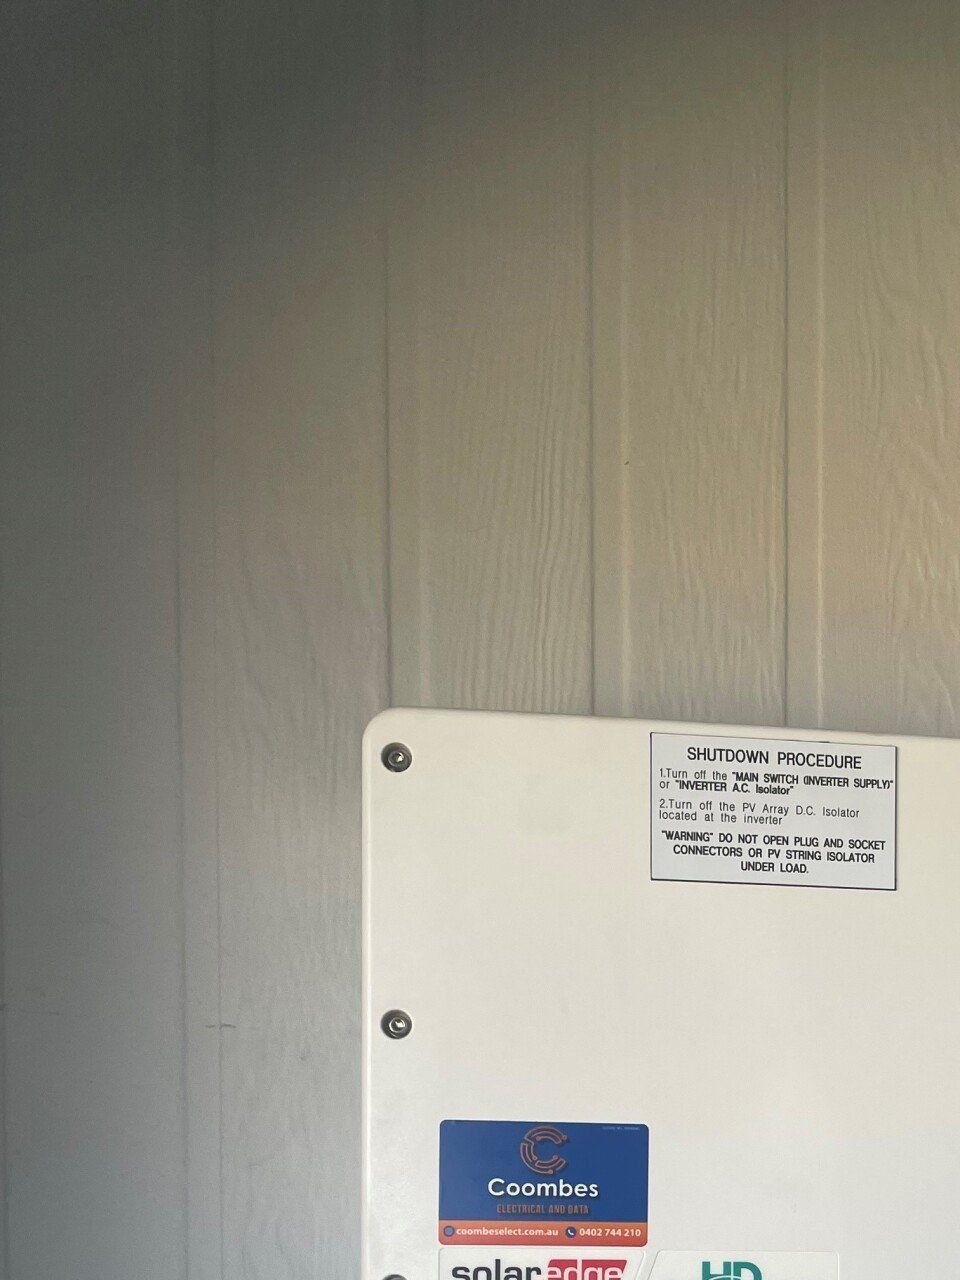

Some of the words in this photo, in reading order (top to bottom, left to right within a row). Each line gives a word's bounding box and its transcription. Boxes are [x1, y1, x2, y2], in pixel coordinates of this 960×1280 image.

[687, 747, 769, 764] SHUTDOWN
[778, 752, 862, 769] PROCEDURE
[659, 768, 687, 779] 1.Turn
[694, 770, 706, 780] off
[712, 770, 727, 781] the
[764, 773, 798, 785] SWITCH
[659, 781, 670, 789] or
[732, 782, 750, 793] A.C.
[659, 799, 692, 810] 2.Turn
[699, 801, 712, 811] off
[719, 802, 735, 811] the
[743, 803, 756, 813] PV
[762, 804, 789, 816] Array
[796, 805, 816, 816] D.C.
[823, 807, 860, 818] Isolator
[659, 810, 697, 821] located
[704, 812, 715, 822] at
[721, 813, 737, 823] the
[743, 814, 782, 825] inverter
[719, 832, 733, 843] DO
[738, 834, 757, 844] NOT
[763, 835, 789, 846] OPEN
[794, 836, 819, 847] PLUG
[824, 838, 843, 848] AND
[848, 839, 886, 850] SOCKET
[673, 845, 743, 857] CONNECTORS
[748, 848, 762, 858] OR
[768, 849, 780, 859] PV
[786, 849, 821, 861] STRING
[827, 852, 875, 863] ISOLATOR
[741, 861, 774, 872] UNDER
[780, 863, 809, 873] LOAD.
[488, 1178, 599, 1197] Coombes
[497, 1204, 545, 1214] ELECTRICAL
[549, 1205, 565, 1214] AND
[568, 1205, 588, 1215] DATA
[456, 1226, 558, 1237] coombeselect.com.au
[580, 1228, 602, 1237] 0402
[605, 1229, 621, 1237] 744
[625, 1229, 641, 1237] 210
